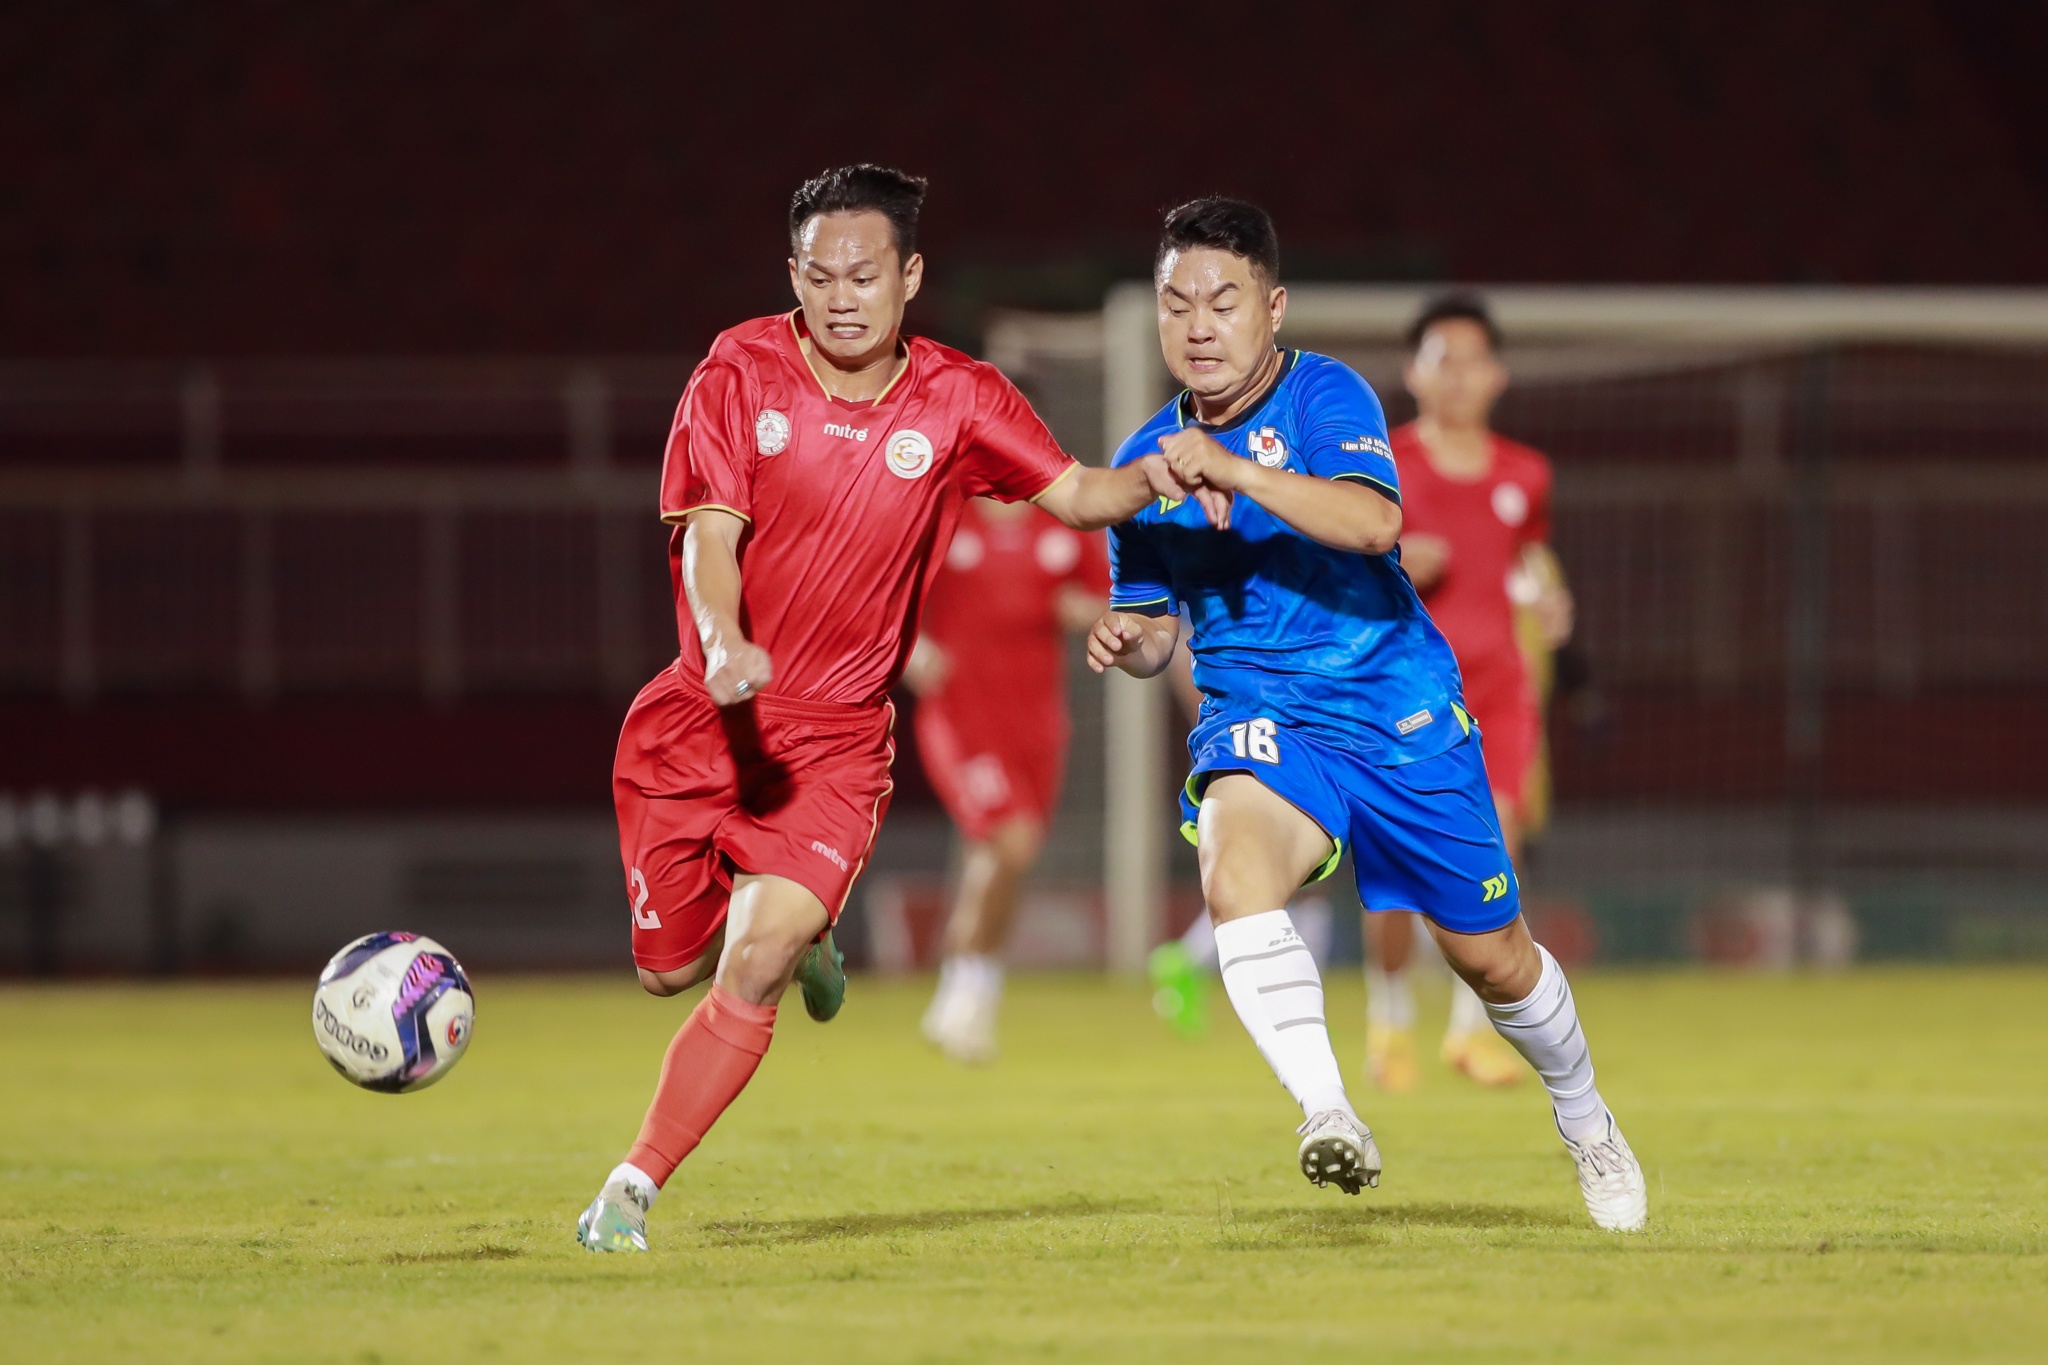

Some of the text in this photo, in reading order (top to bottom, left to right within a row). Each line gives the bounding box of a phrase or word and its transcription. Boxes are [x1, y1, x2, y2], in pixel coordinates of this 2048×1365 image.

[823, 423, 868, 442] mitre
[1229, 717, 1279, 764] 16
[811, 840, 848, 872] mitre
[631, 866, 662, 930] 2
